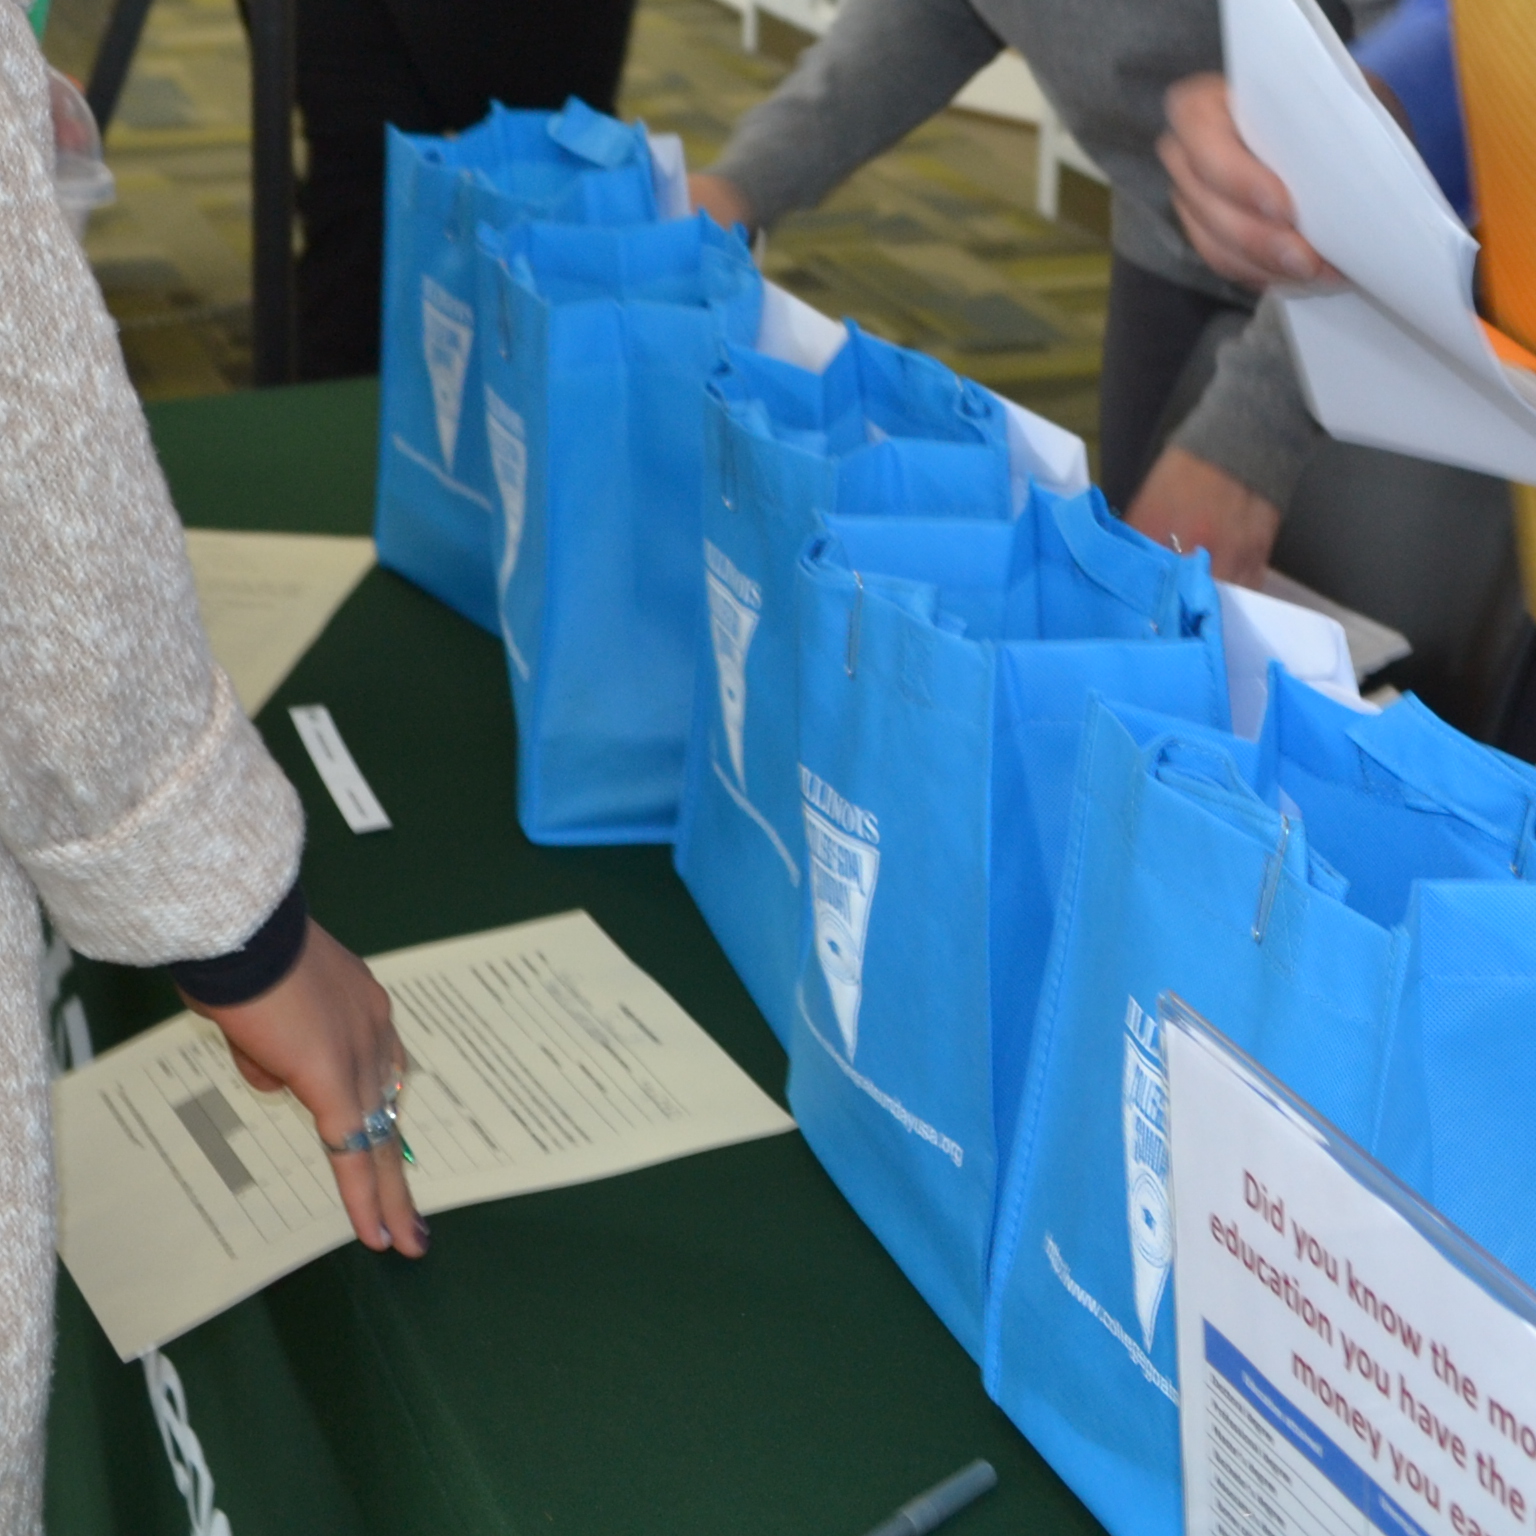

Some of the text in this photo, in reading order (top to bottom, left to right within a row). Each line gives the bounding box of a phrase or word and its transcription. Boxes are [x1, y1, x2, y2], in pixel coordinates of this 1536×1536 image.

[1209, 1212, 1334, 1346] education
[1340, 1328, 1391, 1399] you
[1398, 1373, 1467, 1469] have
[1475, 1450, 1526, 1523] the
[1242, 1168, 1285, 1234] Did
[1291, 1219, 1340, 1284] you
[1346, 1260, 1423, 1358] know
[1430, 1340, 1479, 1410] the
[1291, 1350, 1383, 1460] money
[1388, 1440, 1441, 1514] you
